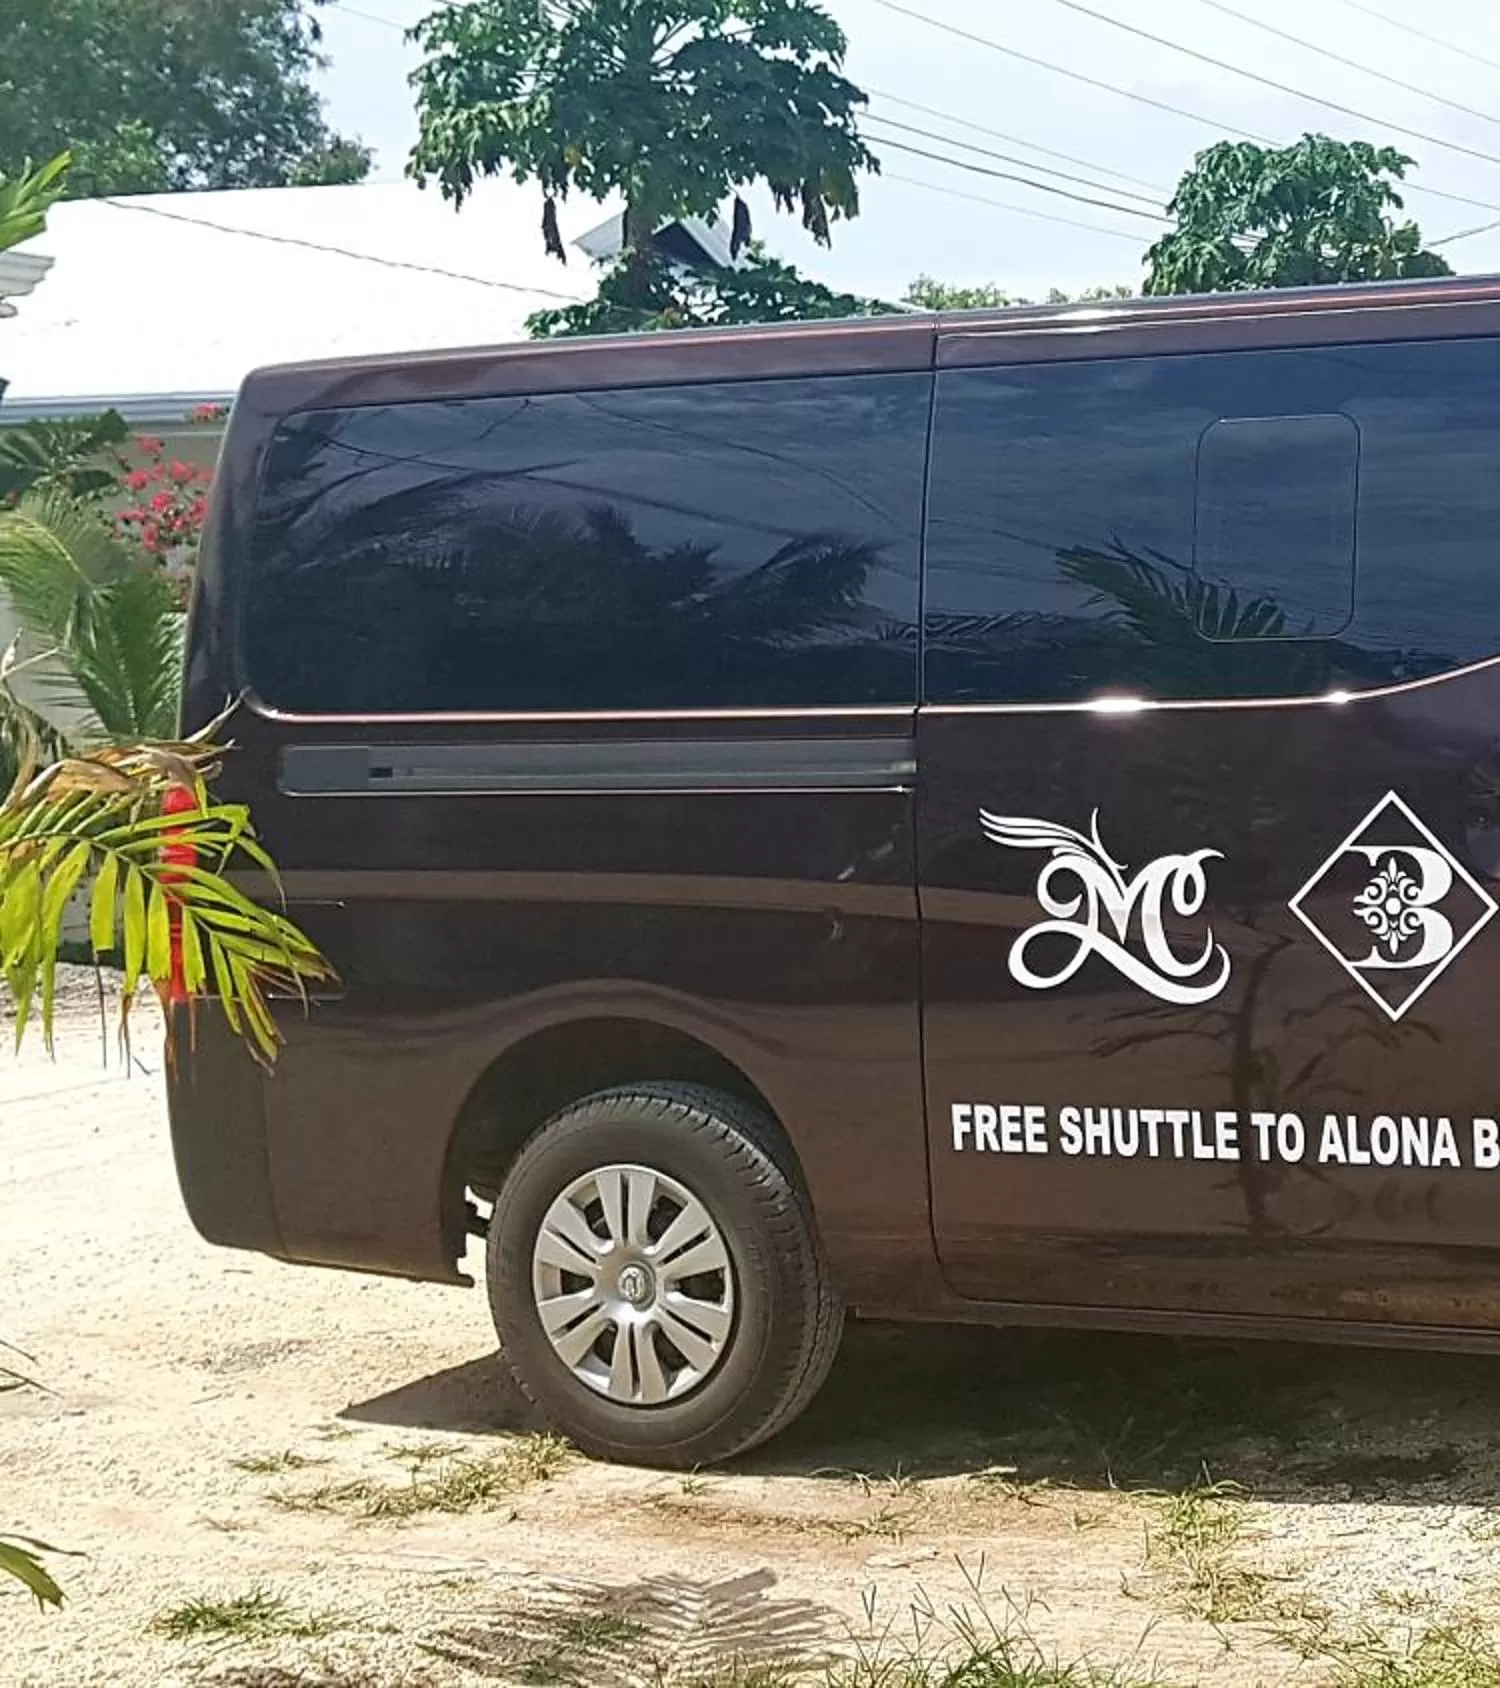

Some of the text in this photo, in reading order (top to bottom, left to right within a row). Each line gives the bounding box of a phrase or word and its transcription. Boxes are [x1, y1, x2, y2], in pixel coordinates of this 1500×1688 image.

[1344, 845, 1455, 969] B
[951, 1103, 1048, 1153] FREE
[1059, 1106, 1240, 1160] SHUTTLE
[1250, 1112, 1305, 1163] TO
[1318, 1114, 1461, 1167] ALONA
